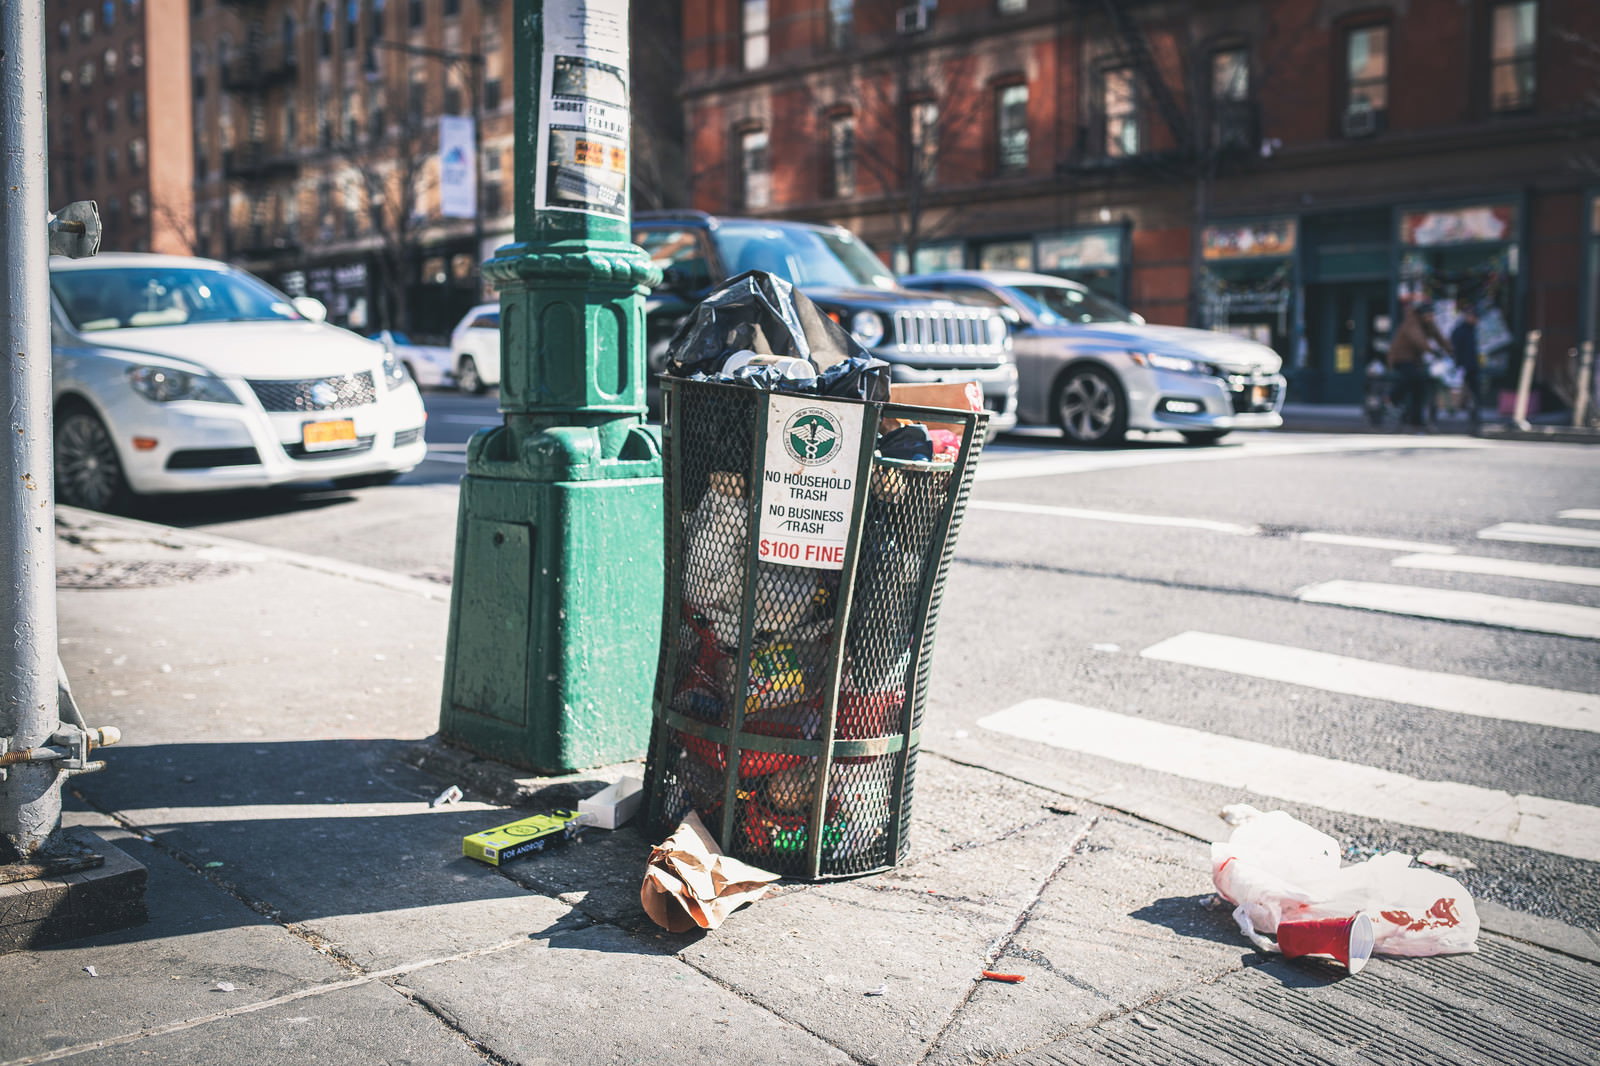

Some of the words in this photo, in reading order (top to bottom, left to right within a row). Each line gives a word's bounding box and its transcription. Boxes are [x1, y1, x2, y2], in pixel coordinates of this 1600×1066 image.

[553, 101, 583, 113] SHORT
[765, 470, 781, 483] NO
[783, 472, 851, 490] HOUSEHOLD
[789, 487, 828, 501] TRASH
[769, 504, 785, 517] NO
[787, 507, 844, 522] BUSINESS
[786, 520, 824, 534] TRASH
[759, 539, 800, 560] $100
[805, 544, 844, 563] FINE
[503, 851, 515, 860] FOR
[516, 840, 545, 854] ANDROID
